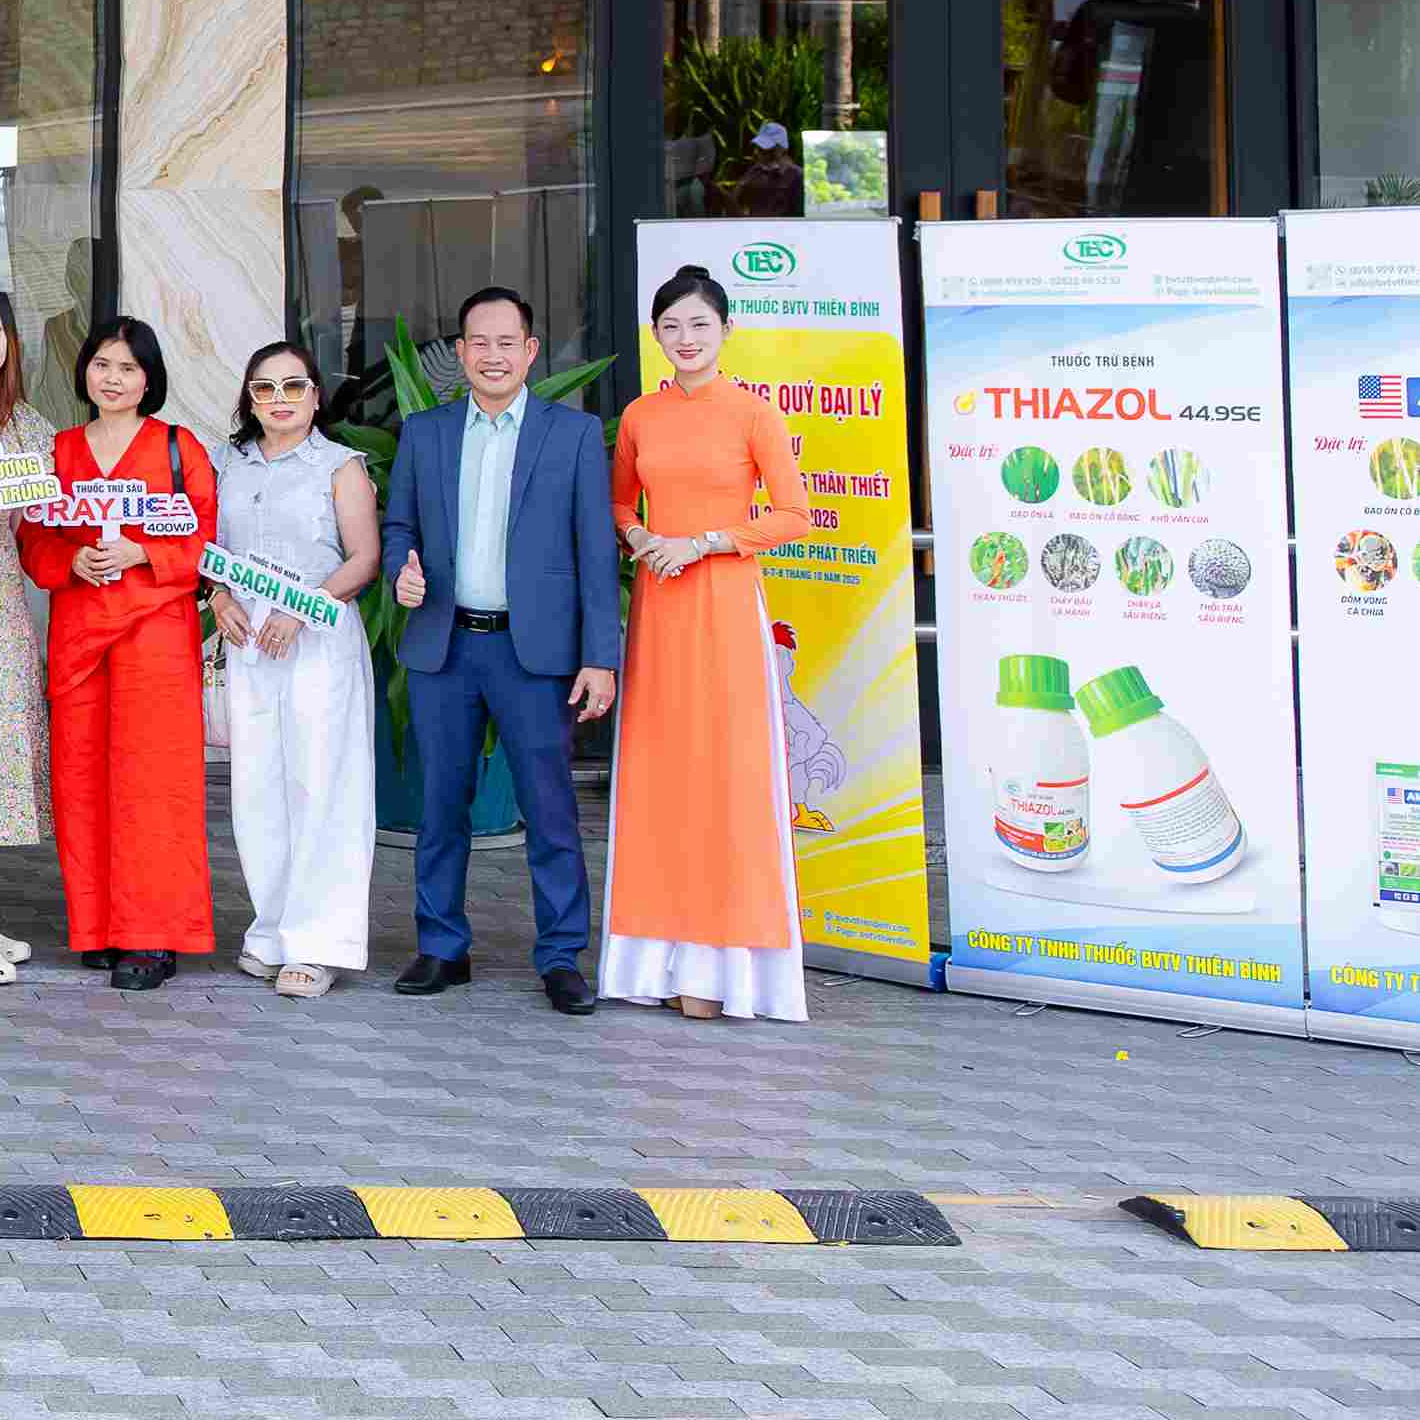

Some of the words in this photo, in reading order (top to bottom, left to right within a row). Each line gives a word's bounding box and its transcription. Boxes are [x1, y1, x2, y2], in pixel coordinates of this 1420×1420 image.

[741, 294, 778, 315] THUỐC
[783, 300, 809, 315] BVTV
[1051, 349, 1091, 368] THUỐC
[1096, 351, 1118, 368] TRỪ
[1122, 354, 1155, 371] BỆNH
[779, 379, 815, 416] QUÝ
[821, 384, 853, 422] ĐẠI
[860, 382, 883, 417] LÝ
[984, 387, 1172, 421] THIAZOL
[1179, 404, 1262, 423] 44.9SE
[811, 470, 847, 495] THÂN
[850, 467, 892, 499] THIẾT
[146, 522, 195, 533] 400WP
[808, 543, 838, 562] PHÁT
[841, 544, 878, 566] TRIỂN
[203, 547, 226, 578] TB
[229, 561, 281, 602] SẠCH
[284, 584, 340, 629] NHỆN
[968, 926, 1011, 953] CÔNG
[1016, 934, 1034, 955] TY
[1038, 937, 1081, 960] TNHH
[1085, 941, 1137, 967] THUỐC
[1141, 950, 1182, 973] BVTV
[1186, 951, 1236, 979] THIÊN
[1240, 957, 1282, 983] BÌNH
[1330, 960, 1380, 989] CÔNG
[1384, 970, 1404, 993] TY
